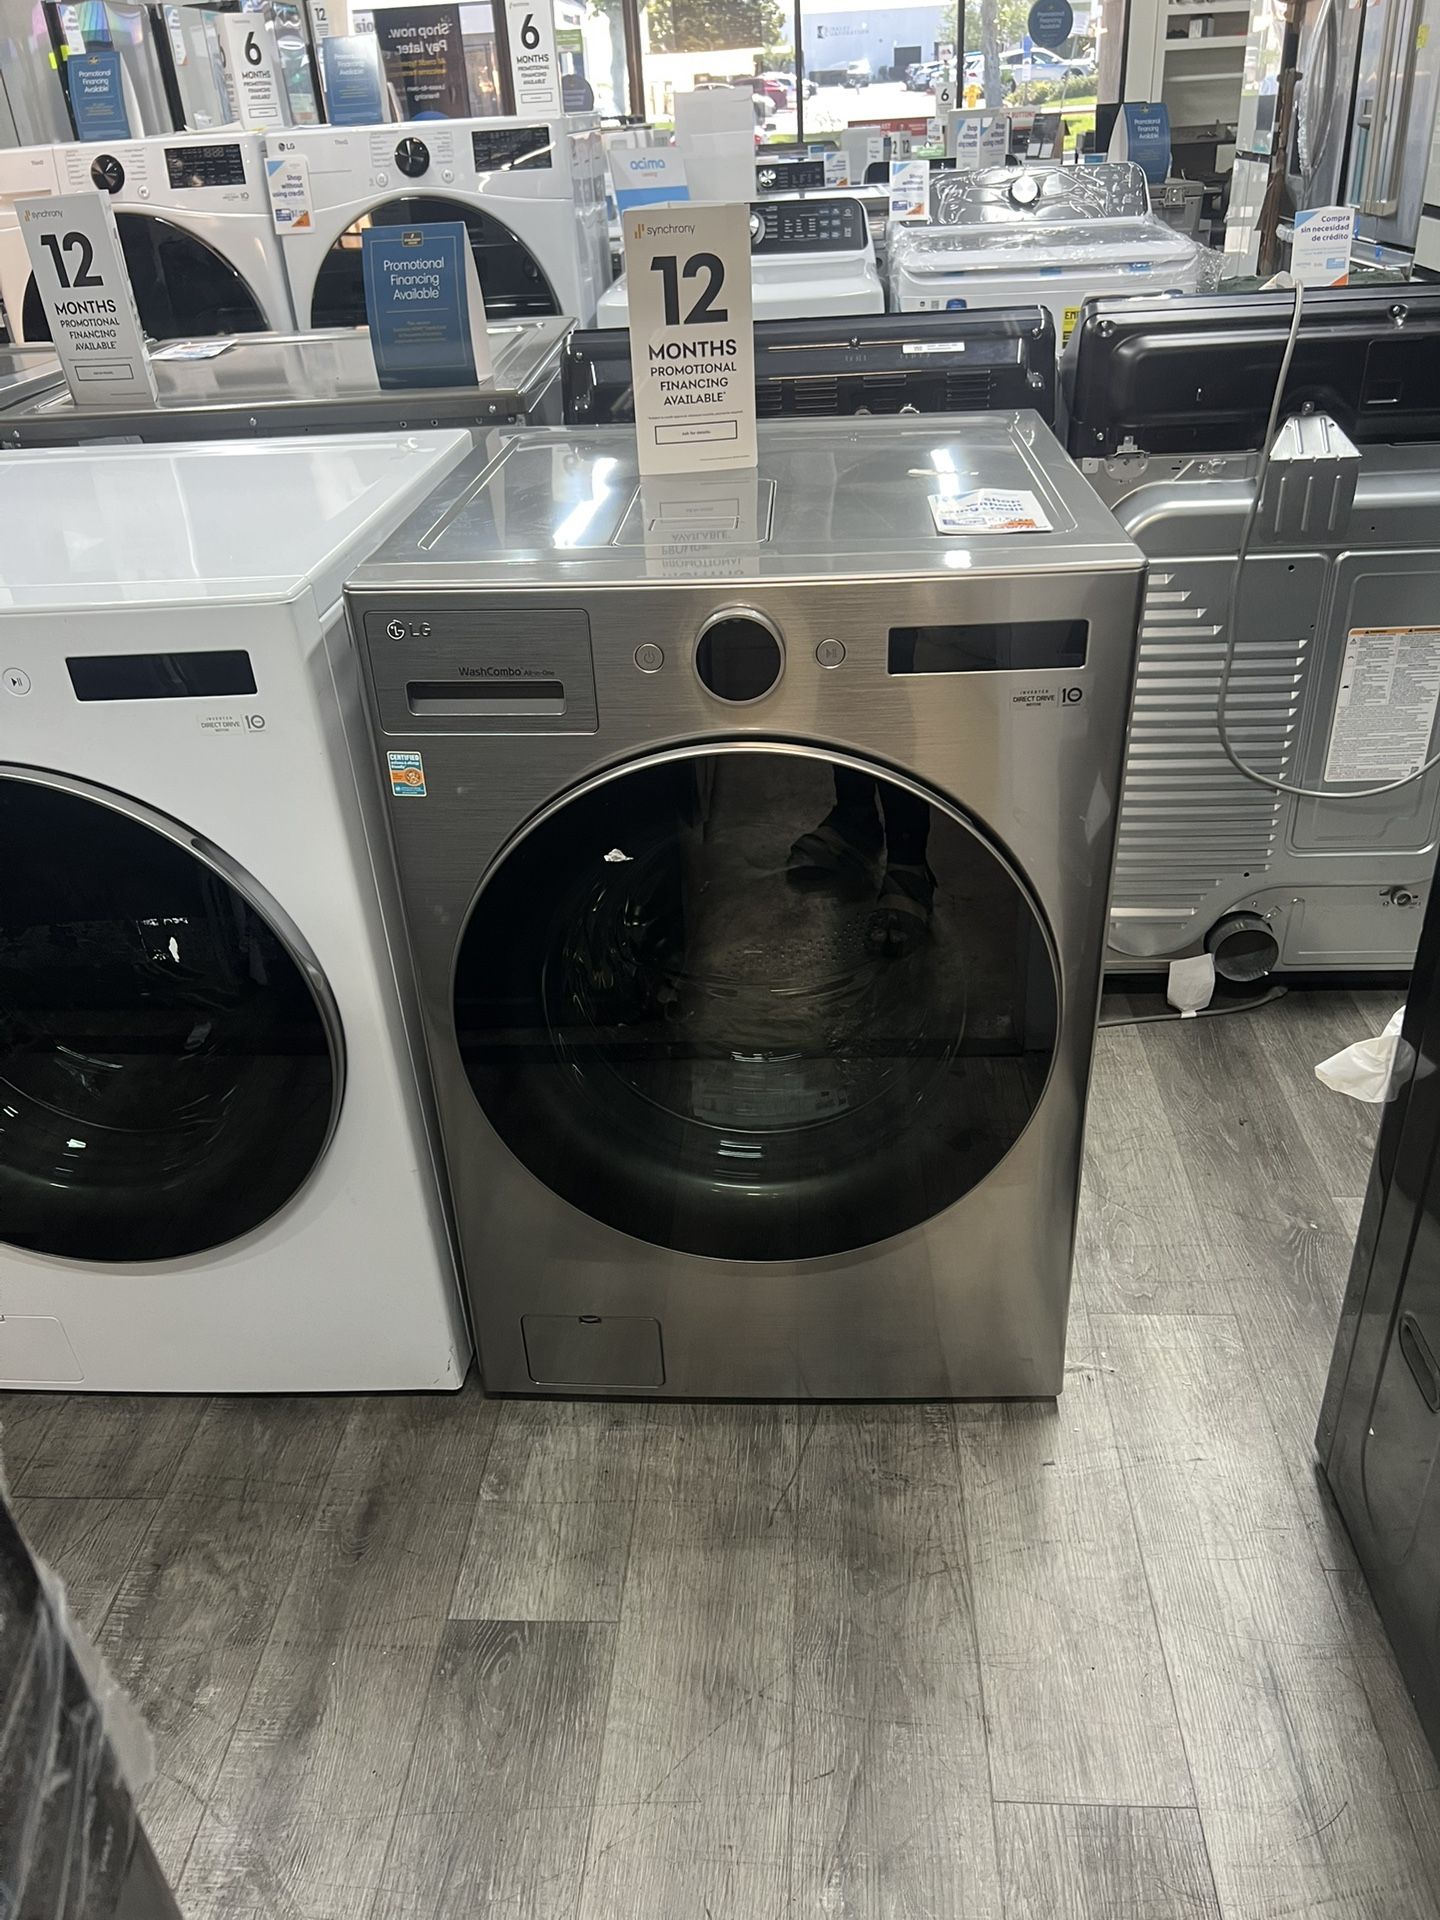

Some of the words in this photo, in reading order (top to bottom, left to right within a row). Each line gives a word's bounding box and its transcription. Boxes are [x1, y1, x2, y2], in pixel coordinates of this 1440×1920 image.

[314, 8, 327, 21] 12
[521, 13, 540, 50] 6
[245, 31, 262, 66] 6
[516, 54, 550, 64] MONTHS
[78, 69, 112, 78] Promotional
[242, 70, 271, 80] MONTHS
[941, 88, 950, 102] 6
[630, 157, 666, 170] acima
[32, 209, 63, 219] synchrony
[1321, 215, 1351, 224] Compra
[646, 223, 696, 237] synchrony
[1301, 226, 1311, 234] sin
[1312, 223, 1350, 233] necesidad
[1322, 233, 1349, 241] crédito
[40, 231, 104, 289] 12
[384, 256, 445, 272] Promotional
[390, 272, 440, 287] Financing
[650, 252, 728, 326] 12
[54, 299, 117, 316] MONTHS
[60, 317, 120, 329] PROMOTIONAL
[69, 329, 117, 340] FINANCING
[648, 338, 738, 361] MONTHS
[650, 362, 737, 377] PROMOTIONAL
[660, 377, 729, 391] FINANCING
[408, 621, 432, 637] LG
[1062, 687, 1083, 703] 10
[245, 714, 266, 729] 10
